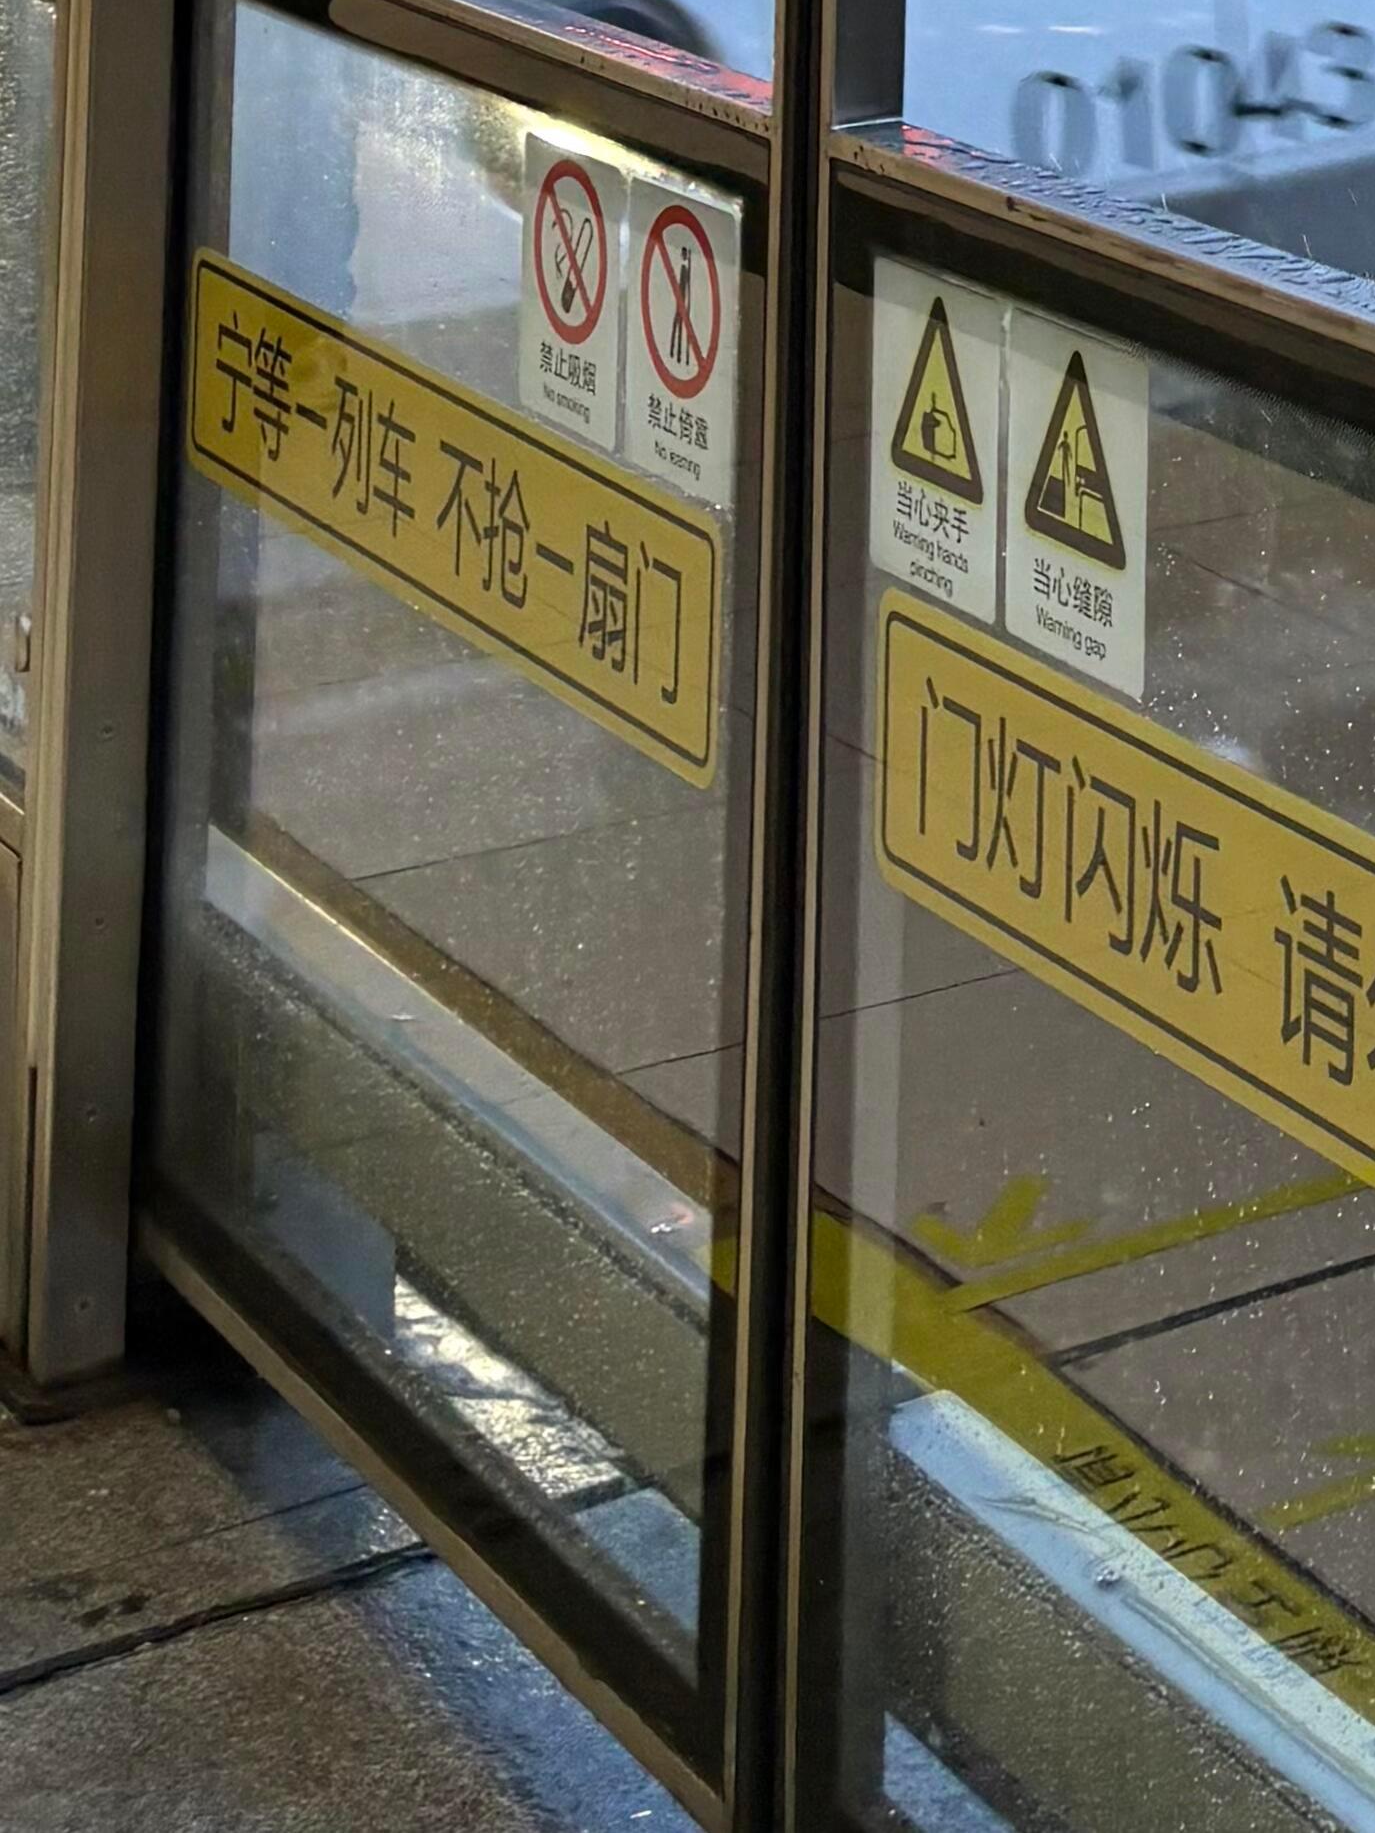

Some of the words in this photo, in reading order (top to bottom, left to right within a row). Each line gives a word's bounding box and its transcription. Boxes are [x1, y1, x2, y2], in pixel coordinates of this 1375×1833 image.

[215, 311, 416, 538] 宁等一列车
[437, 438, 684, 705] 不抢一扇门
[896, 481, 970, 544] 当心夹手
[892, 519, 935, 563] Warning
[936, 539, 969, 574] hands
[1033, 557, 1113, 629] 当心缝隙
[1036, 604, 1082, 651] Warning
[1084, 635, 1107, 661] gap
[917, 677, 1224, 998] 门灯闪烁
